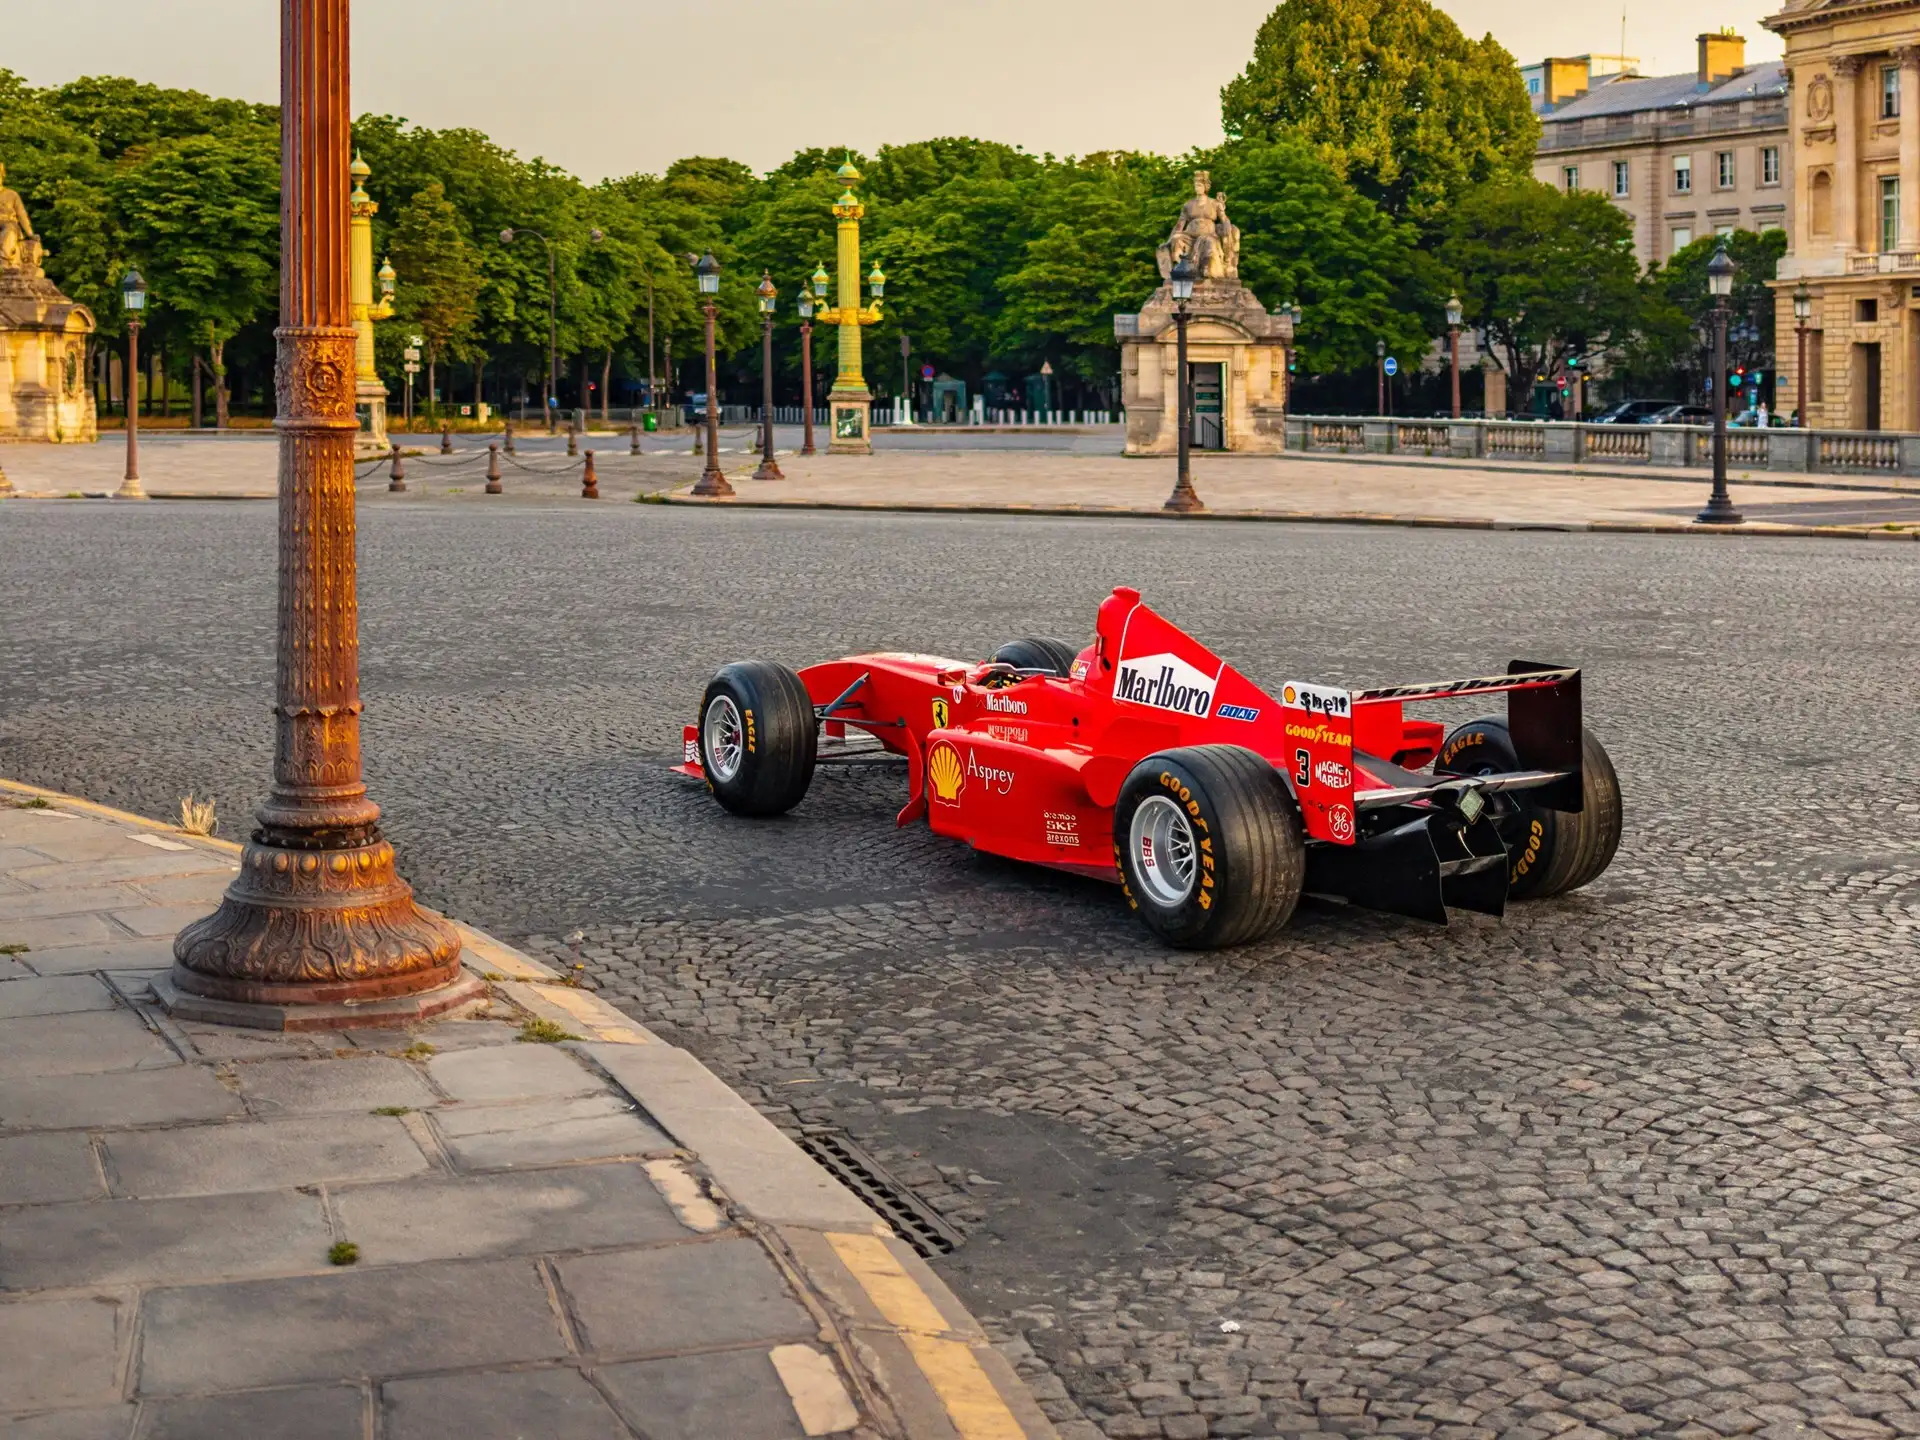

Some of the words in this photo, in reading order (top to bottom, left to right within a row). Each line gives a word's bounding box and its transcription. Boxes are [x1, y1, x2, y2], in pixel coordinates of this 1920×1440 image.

[986, 693, 1028, 714] Marlboro
[1116, 666, 1210, 716] Marlboro
[1218, 704, 1258, 720] FIAT
[744, 709, 756, 754] EAGLE
[1443, 732, 1486, 765] EAGLE
[967, 747, 1015, 795] Asprey
[1296, 747, 1311, 788] 3
[1045, 820, 1078, 831] SKF
[1046, 833, 1080, 844] arexons
[1142, 836, 1155, 867] BBS
